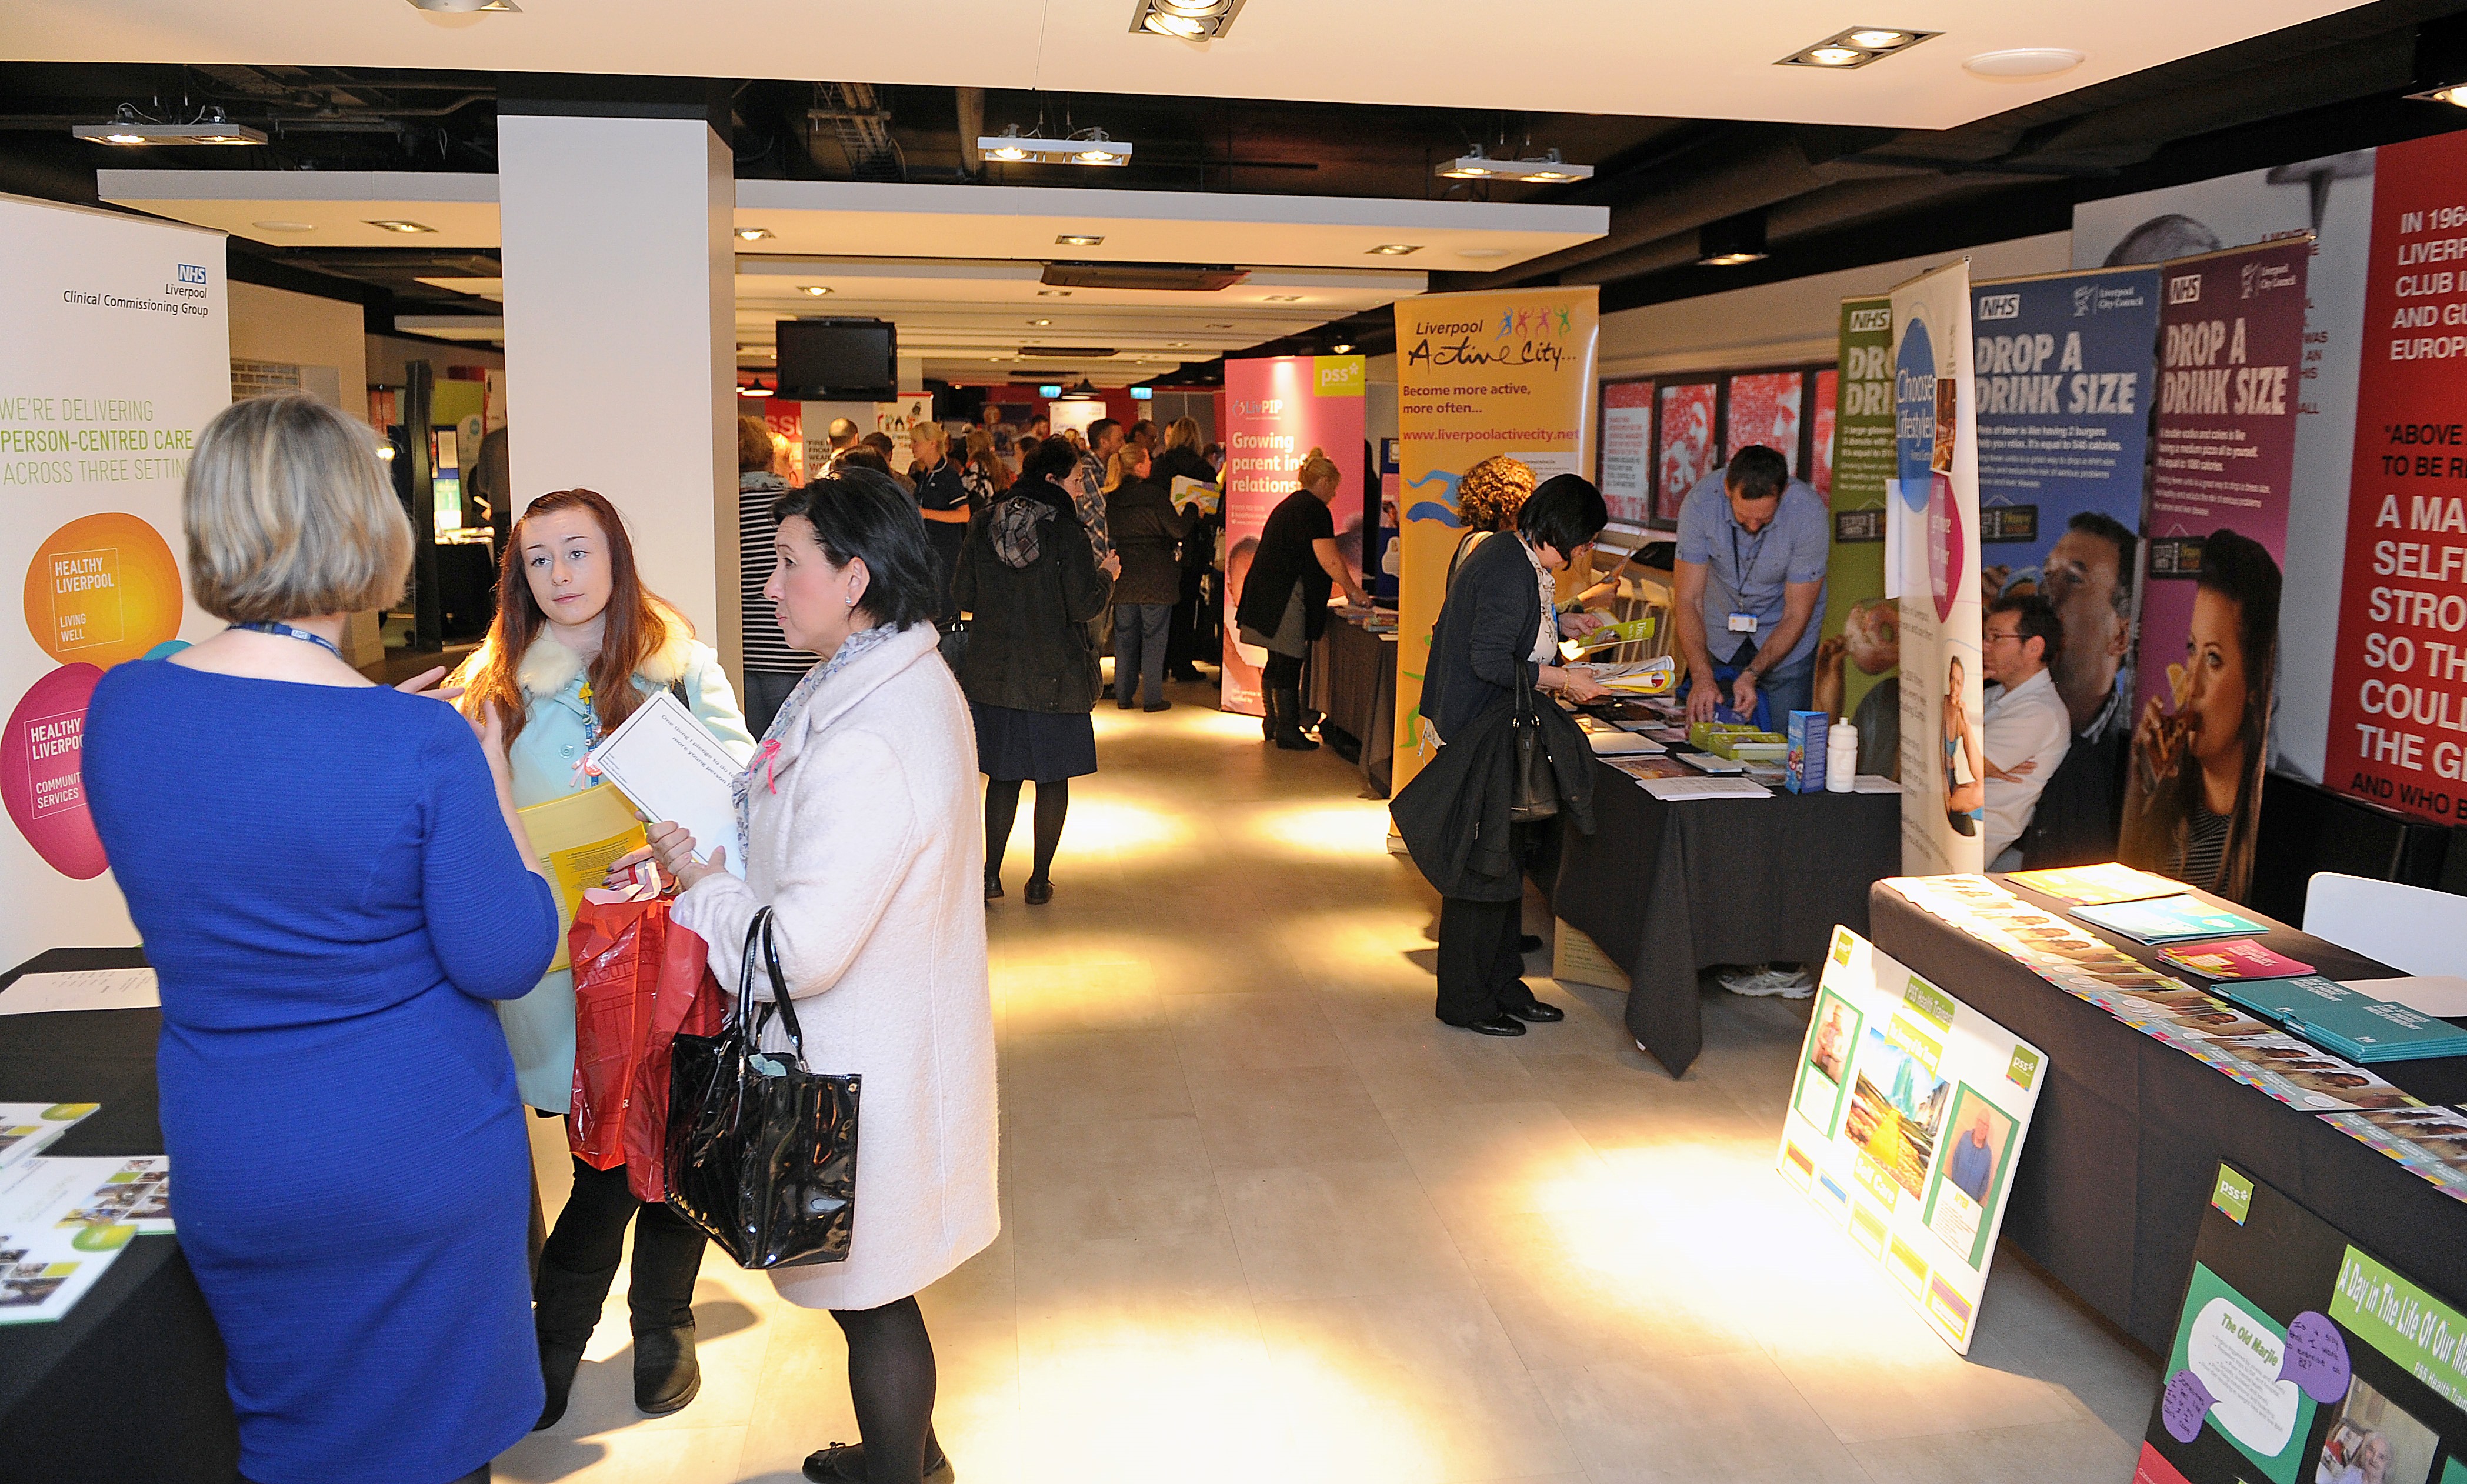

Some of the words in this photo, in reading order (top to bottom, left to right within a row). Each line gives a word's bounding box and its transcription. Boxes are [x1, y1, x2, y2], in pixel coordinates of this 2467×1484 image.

[2401, 211, 2423, 234] IN
[2428, 206, 2467, 230] 196
[2398, 238, 2467, 265] LIVERP
[179, 265, 205, 283] NHS
[2396, 272, 2454, 298] CLUB
[2459, 271, 2467, 291] I
[166, 284, 207, 298] Liverpool
[2171, 276, 2200, 304] NHS
[63, 291, 101, 305] Clinical
[104, 295, 178, 315] Commissioning
[181, 303, 208, 318] Group
[1981, 296, 2018, 318] NHS
[2392, 306, 2439, 328] AND
[1416, 320, 1483, 336] Liverpool
[1851, 311, 1889, 330] NHS
[1408, 336, 1526, 374] Active
[1976, 332, 2055, 374] DROP
[2059, 331, 2083, 372] A
[2166, 321, 2226, 367] DROP
[2229, 318, 2246, 364] A
[2389, 336, 2467, 361] EUROP
[1848, 346, 1895, 379] DR
[1322, 367, 1348, 386] pss
[1898, 368, 1933, 403] Choose
[1403, 386, 1449, 396] Become
[1453, 386, 1487, 395] more
[1491, 383, 1531, 395] active,
[1845, 382, 1895, 415] DRI
[1976, 374, 2063, 415] DRINK
[2068, 372, 2138, 415] SIZE
[2162, 369, 2231, 414] DRINK
[2235, 366, 2289, 415] SIZE
[0, 398, 55, 421] WE'RE
[62, 399, 153, 421] DELIVERING
[1246, 399, 1283, 414] LivPIP
[1403, 405, 1433, 413] more
[1, 430, 148, 452] PERSON-CENTRED
[154, 430, 194, 450] CARE
[1232, 432, 1294, 453] Growing
[1403, 429, 1579, 442] www.liverpoolactivecity.net
[4, 462, 74, 485] ACROSS
[78, 459, 129, 482] THREE
[135, 458, 192, 480] SETTIN
[1232, 455, 1281, 474] parent
[1284, 453, 1307, 471] inf
[2382, 455, 2409, 476] TO
[2416, 456, 2443, 477] BE
[2449, 457, 2467, 478] R
[1232, 476, 1302, 492] relations
[2375, 495, 2401, 528] A
[55, 558, 103, 576] HEALTHY
[2373, 541, 2467, 583] SELF
[56, 574, 114, 593] LIVERPOOL
[60, 614, 86, 628] LIVING
[2369, 586, 2467, 632] STRO
[61, 629, 85, 642] WELL
[2364, 632, 2416, 672] SO
[2424, 641, 2467, 682] TH
[31, 718, 81, 742] HEALTHY
[661, 715, 674, 726] One
[674, 726, 689, 740] thing
[692, 742, 712, 759] pledge
[32, 735, 84, 760] LIVERPO
[2356, 723, 2425, 771] THE
[672, 737, 688, 751] more
[688, 751, 706, 768] young
[706, 766, 726, 783] person
[36, 772, 82, 794] COMMUNIT
[2352, 773, 2394, 798] AND
[2401, 783, 2450, 815] WHO
[38, 787, 79, 809] SERVICES
[1907, 983, 1918, 1002] PSS
[1916, 990, 1933, 1013] Health
[2013, 1056, 2028, 1073] pss
[1873, 1175, 1895, 1204] Care
[2221, 1180, 2239, 1200] pss
[2337, 1258, 2351, 1292] A
[2347, 1263, 2370, 1313] Day
[2365, 1276, 2380, 1312] in
[2378, 1283, 2400, 1326] The
[2396, 1296, 2420, 1340] Life
[2418, 1310, 2438, 1349] Of
[2432, 1320, 2456, 1363] Our
[2222, 1313, 2236, 1334] The
[2238, 1326, 2253, 1346] Old
[2413, 1362, 2428, 1380] PSS
[2428, 1372, 2450, 1397] Health
[2451, 1388, 2467, 1412] Train
